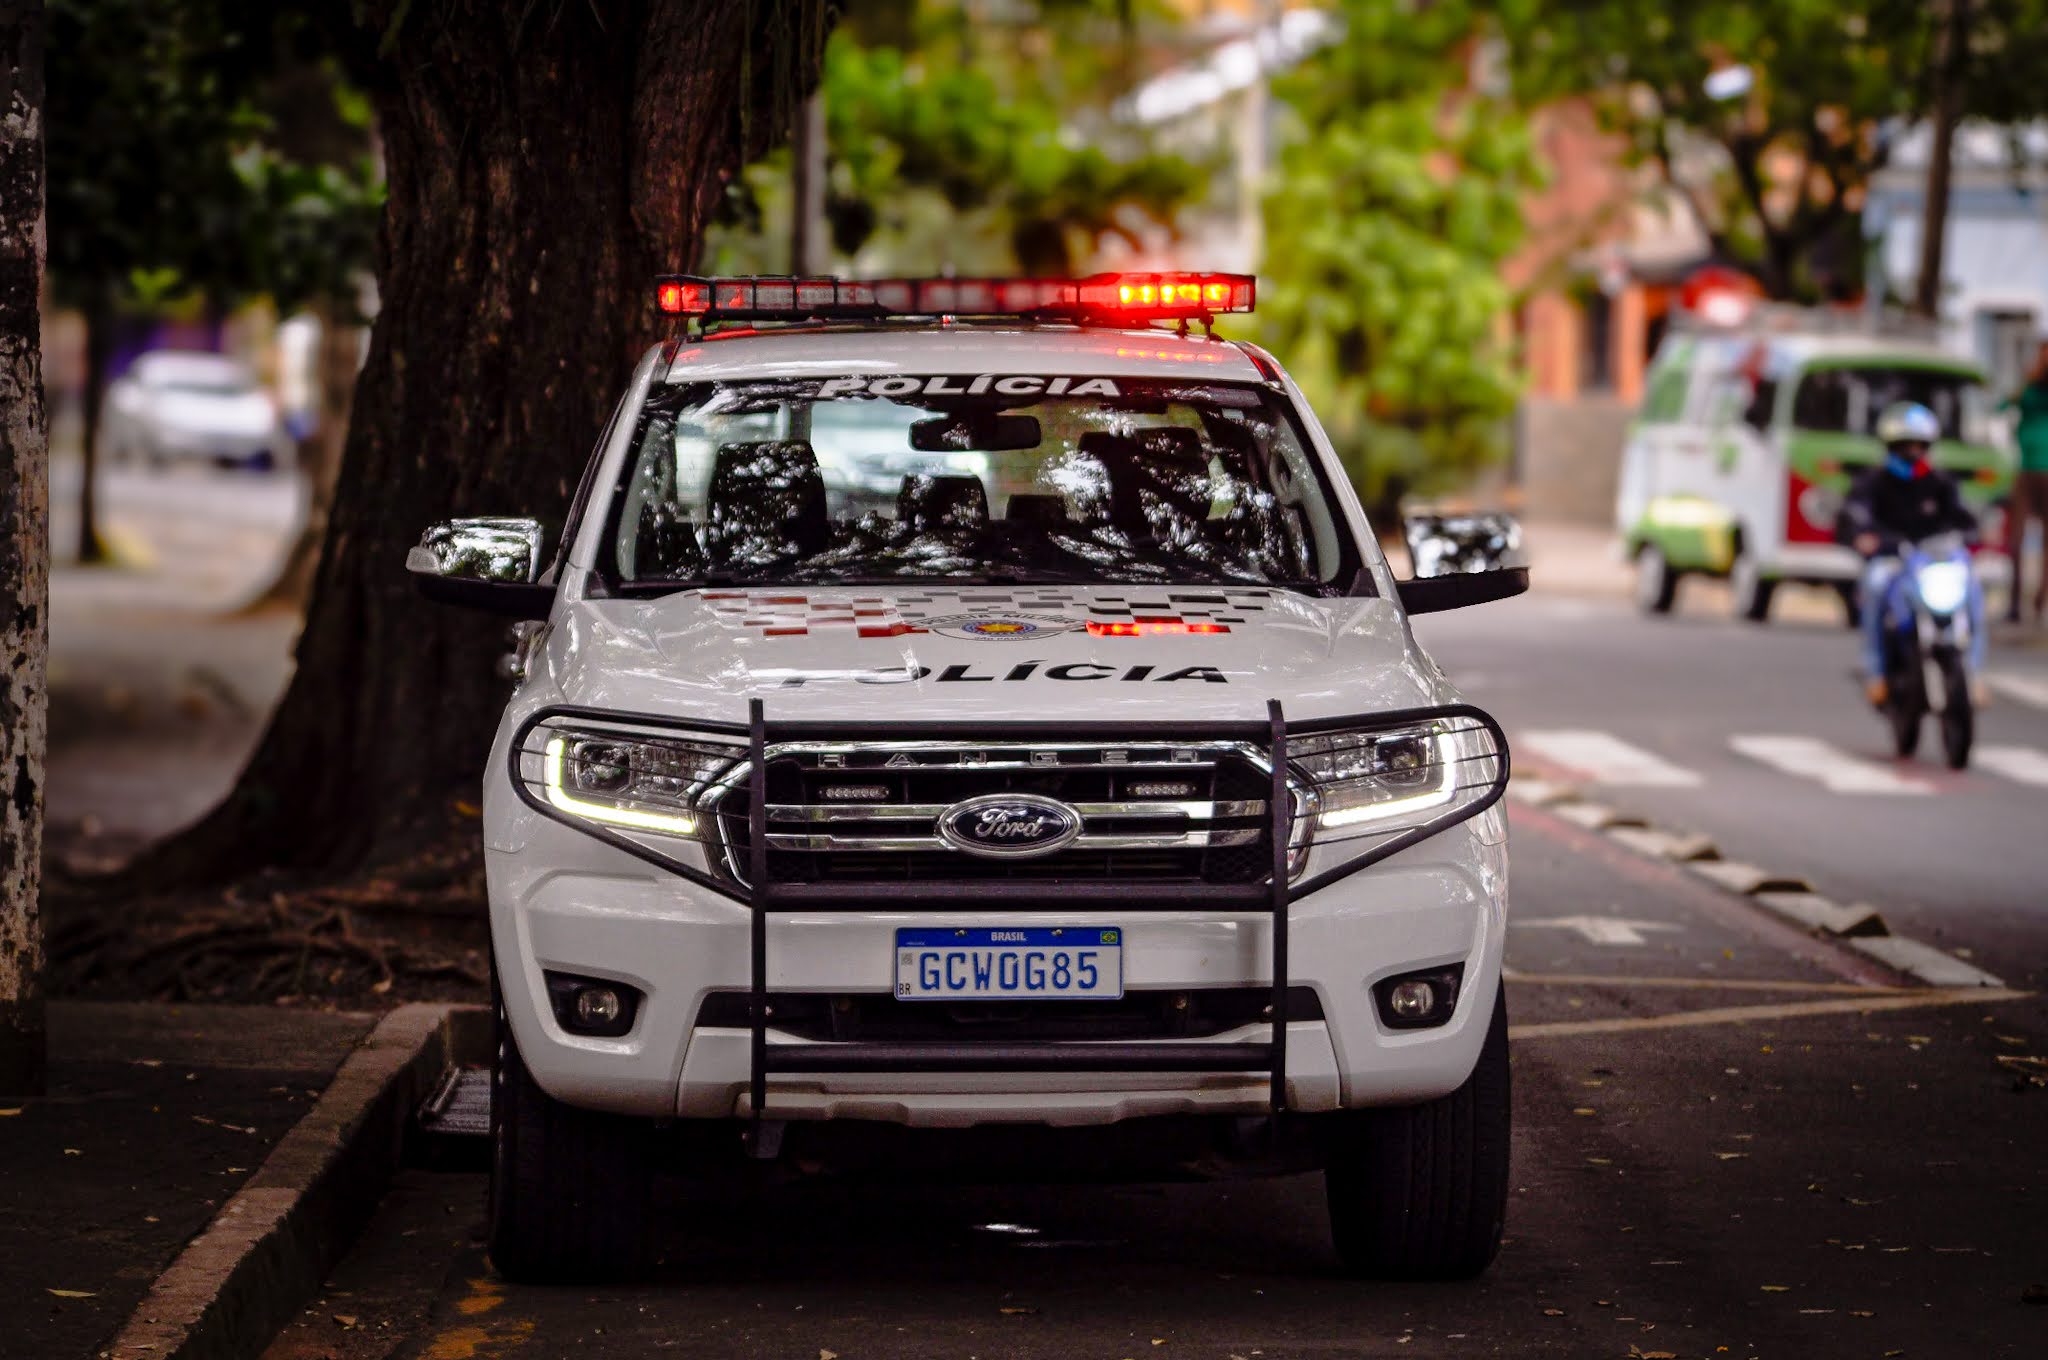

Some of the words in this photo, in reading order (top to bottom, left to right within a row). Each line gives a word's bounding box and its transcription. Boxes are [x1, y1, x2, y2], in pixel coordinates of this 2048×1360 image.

[817, 374, 1121, 398] POLÍCIA
[780, 659, 1229, 687] OLÍCIA
[817, 750, 1199, 767] RANGER
[975, 808, 1043, 838] Ford
[991, 932, 1025, 941] BRASIL
[899, 983, 911, 995] BR
